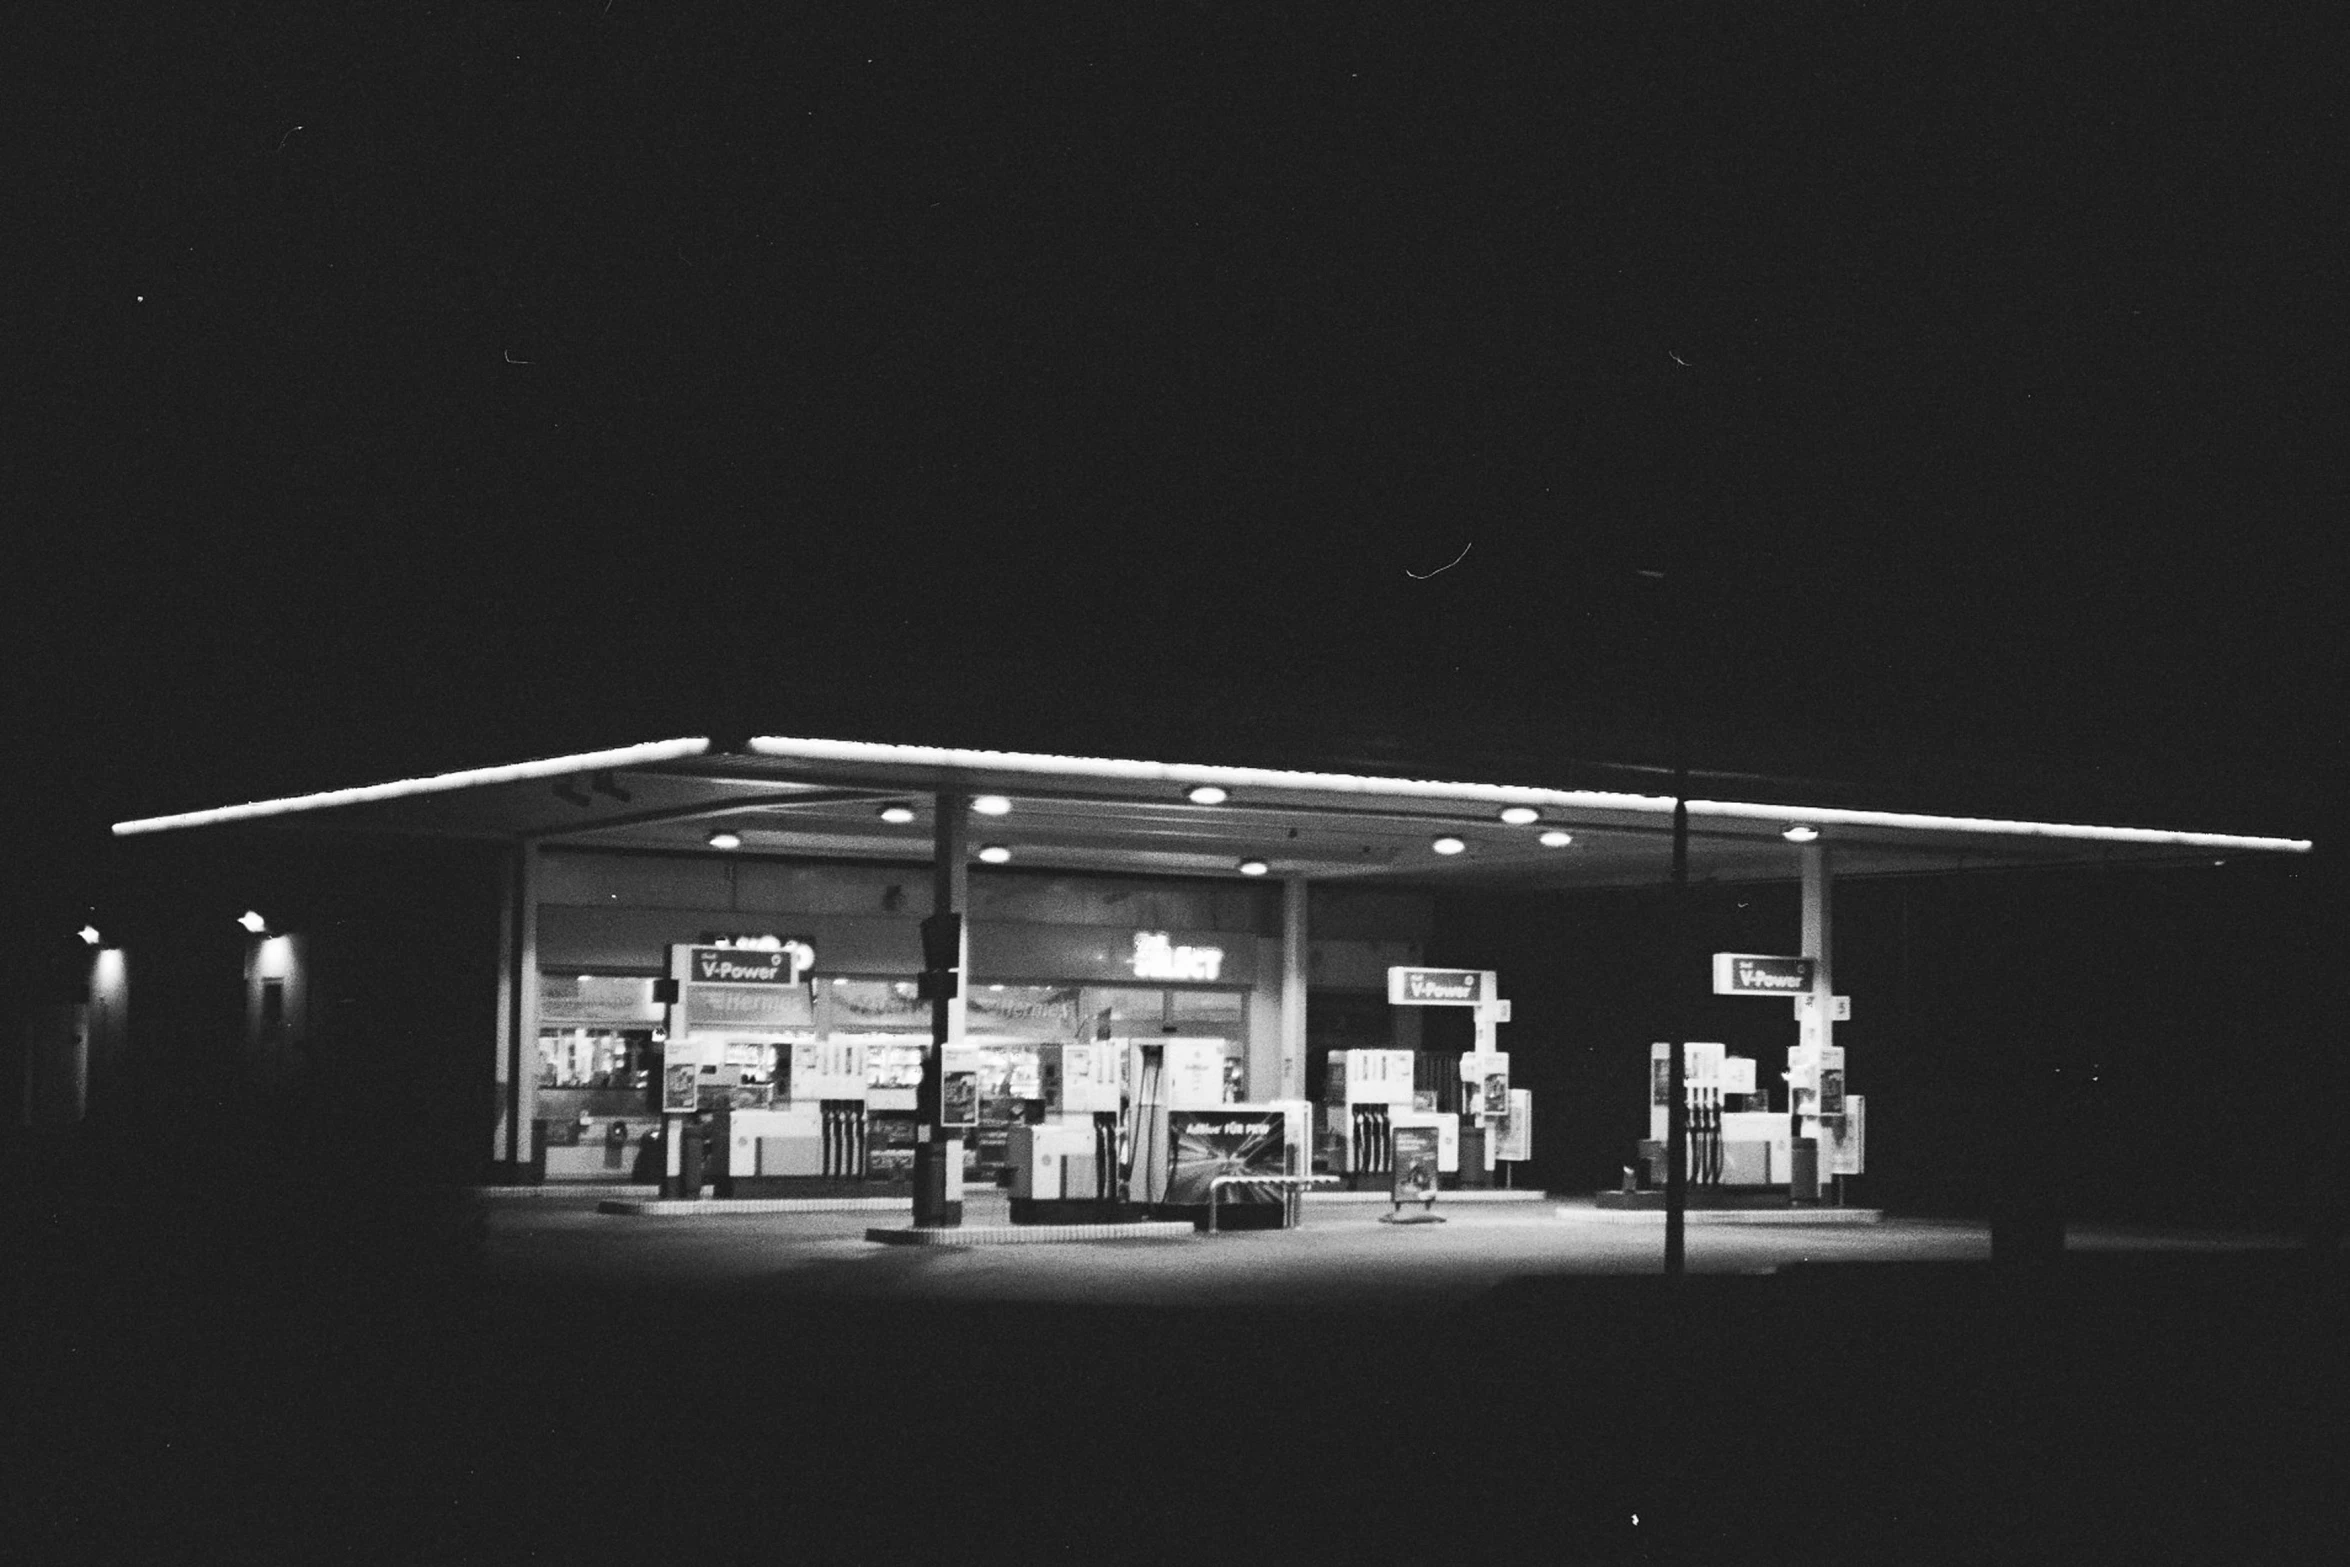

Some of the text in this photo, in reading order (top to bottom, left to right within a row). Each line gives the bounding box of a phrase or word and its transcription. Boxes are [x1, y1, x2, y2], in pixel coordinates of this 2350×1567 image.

[702, 961, 778, 980] V-Power
[1740, 969, 1803, 988] V-Power
[1411, 981, 1473, 998] V-Power
[1224, 1121, 1243, 1135] FÜR
